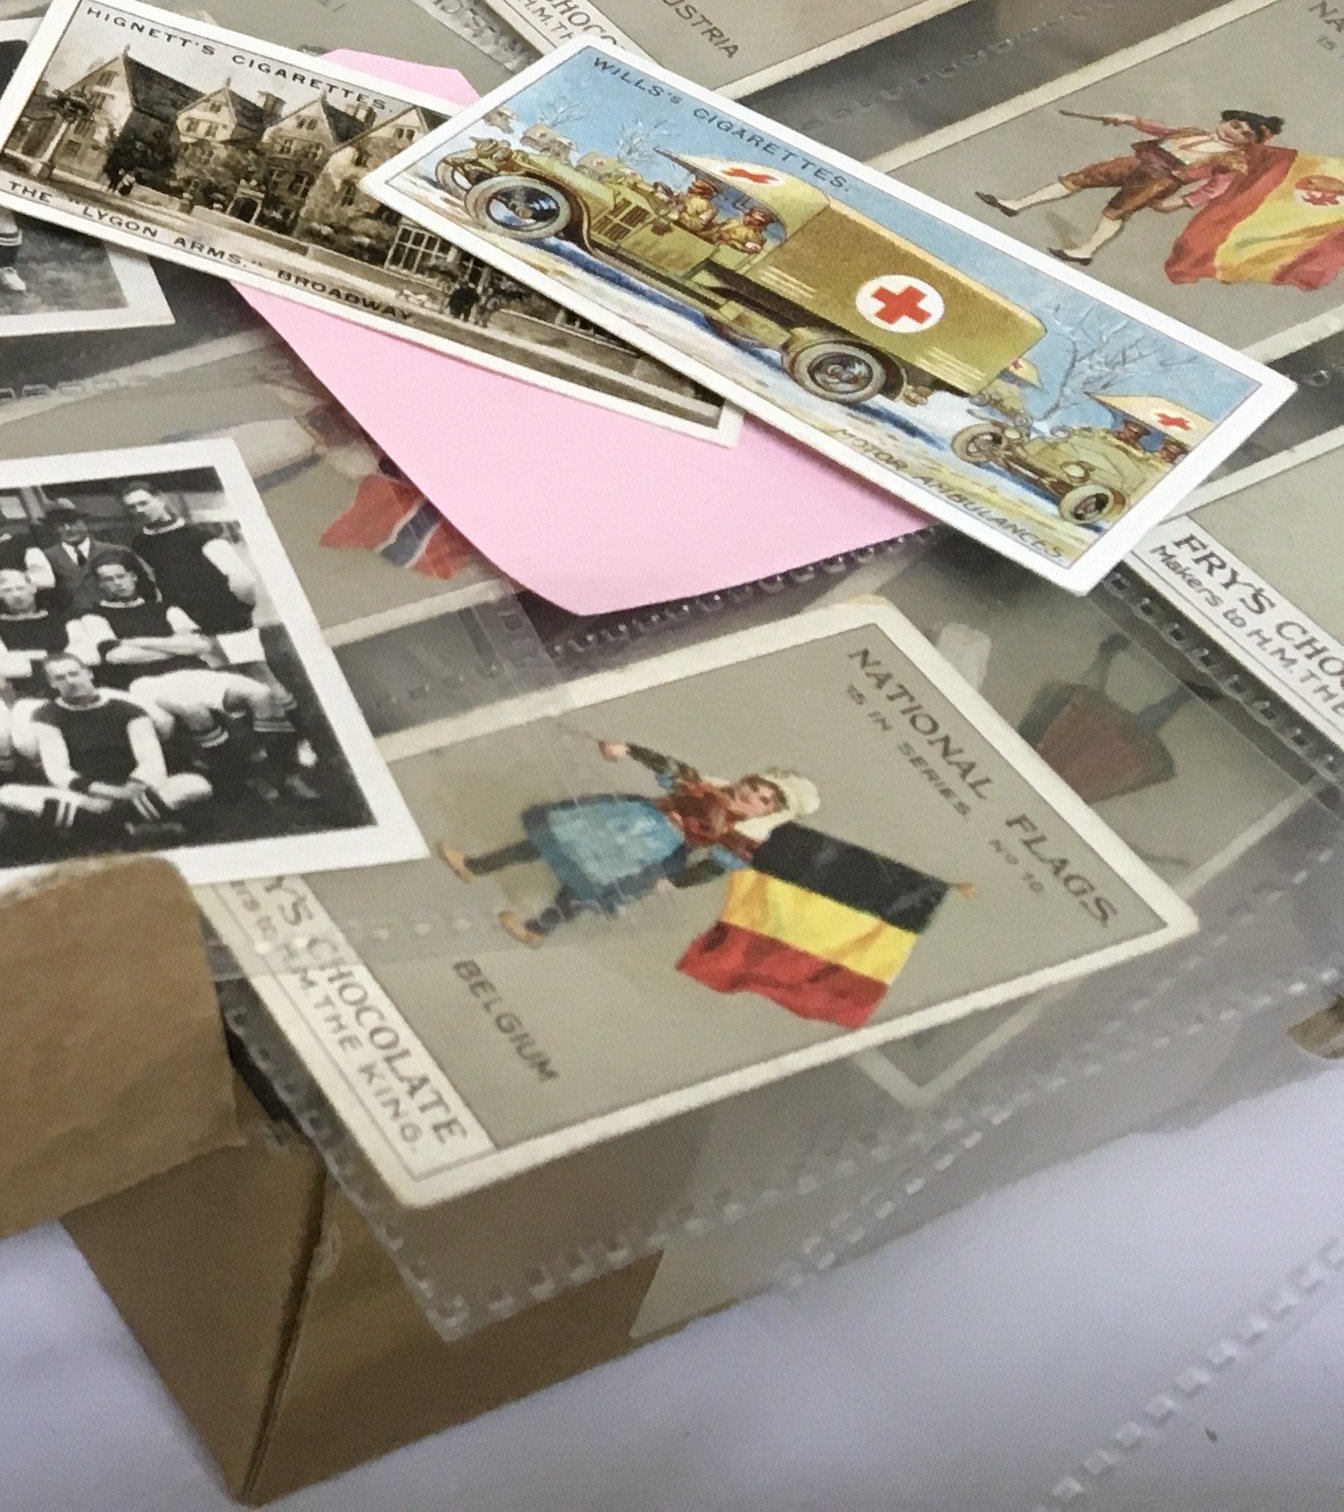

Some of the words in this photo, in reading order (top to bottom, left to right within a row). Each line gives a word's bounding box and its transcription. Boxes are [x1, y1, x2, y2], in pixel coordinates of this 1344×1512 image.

[86, 7, 216, 56] HIGNETT'S
[594, 57, 682, 105] WILLS'S
[9, 181, 53, 203] THE
[278, 270, 412, 320] BROADWAY
[832, 429, 909, 471] MOTOR
[913, 476, 1064, 560] AMBULANCES
[1149, 544, 1225, 608] Makers
[1222, 608, 1247, 628] to
[1172, 533, 1277, 615] FRY'S
[848, 647, 993, 800] NATIONAL
[306, 937, 468, 1146] CHOCOLATE
[453, 959, 561, 1084] BELGIUM
